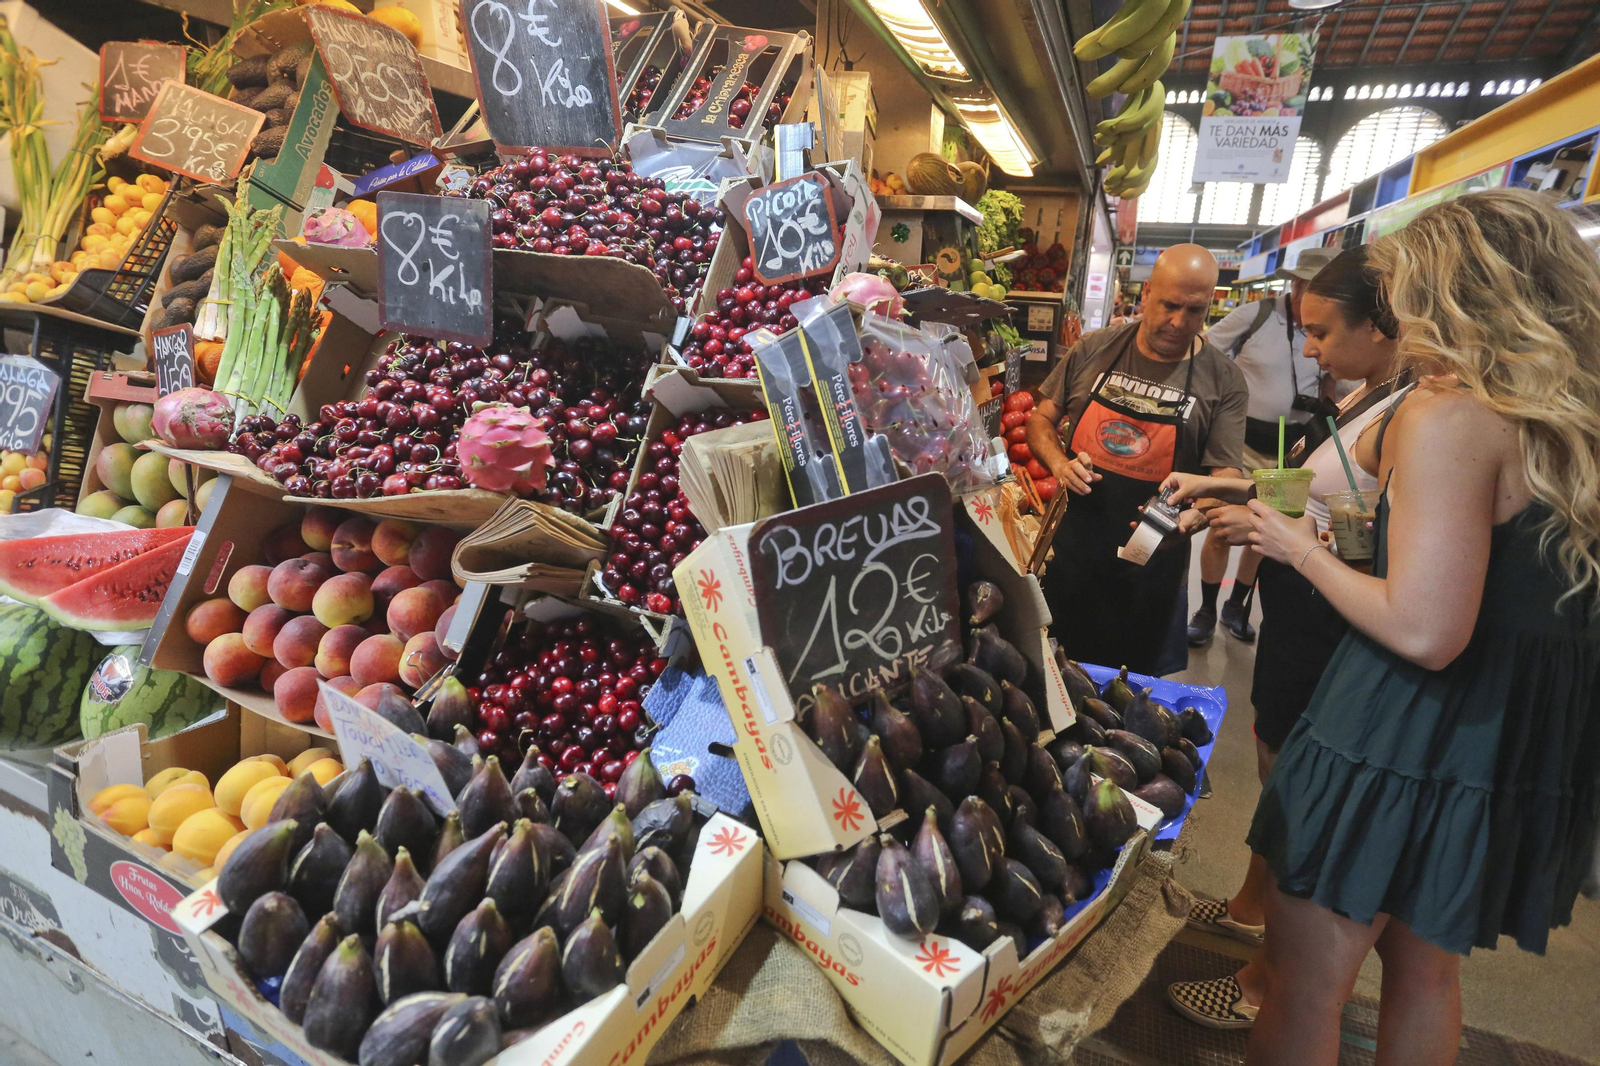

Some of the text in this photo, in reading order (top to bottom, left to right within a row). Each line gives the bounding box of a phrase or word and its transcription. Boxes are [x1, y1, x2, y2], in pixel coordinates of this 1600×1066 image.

[295, 79, 333, 162] Avocados
[1209, 121, 1289, 137] TE DAN MÁS
[1215, 137, 1279, 149] VARIEDAD
[0, 363, 51, 399] ALAGA
[782, 397, 798, 431] Pérez
[831, 373, 848, 409] Pérez
[841, 407, 859, 448] Flores
[712, 621, 774, 772] Cambayas
[1047, 656, 1073, 717] Cambayas
[119, 875, 145, 900] Hnos.
[128, 867, 158, 892] Frutas
[763, 905, 861, 987] ambayas
[1011, 913, 1098, 994] Cambayas
